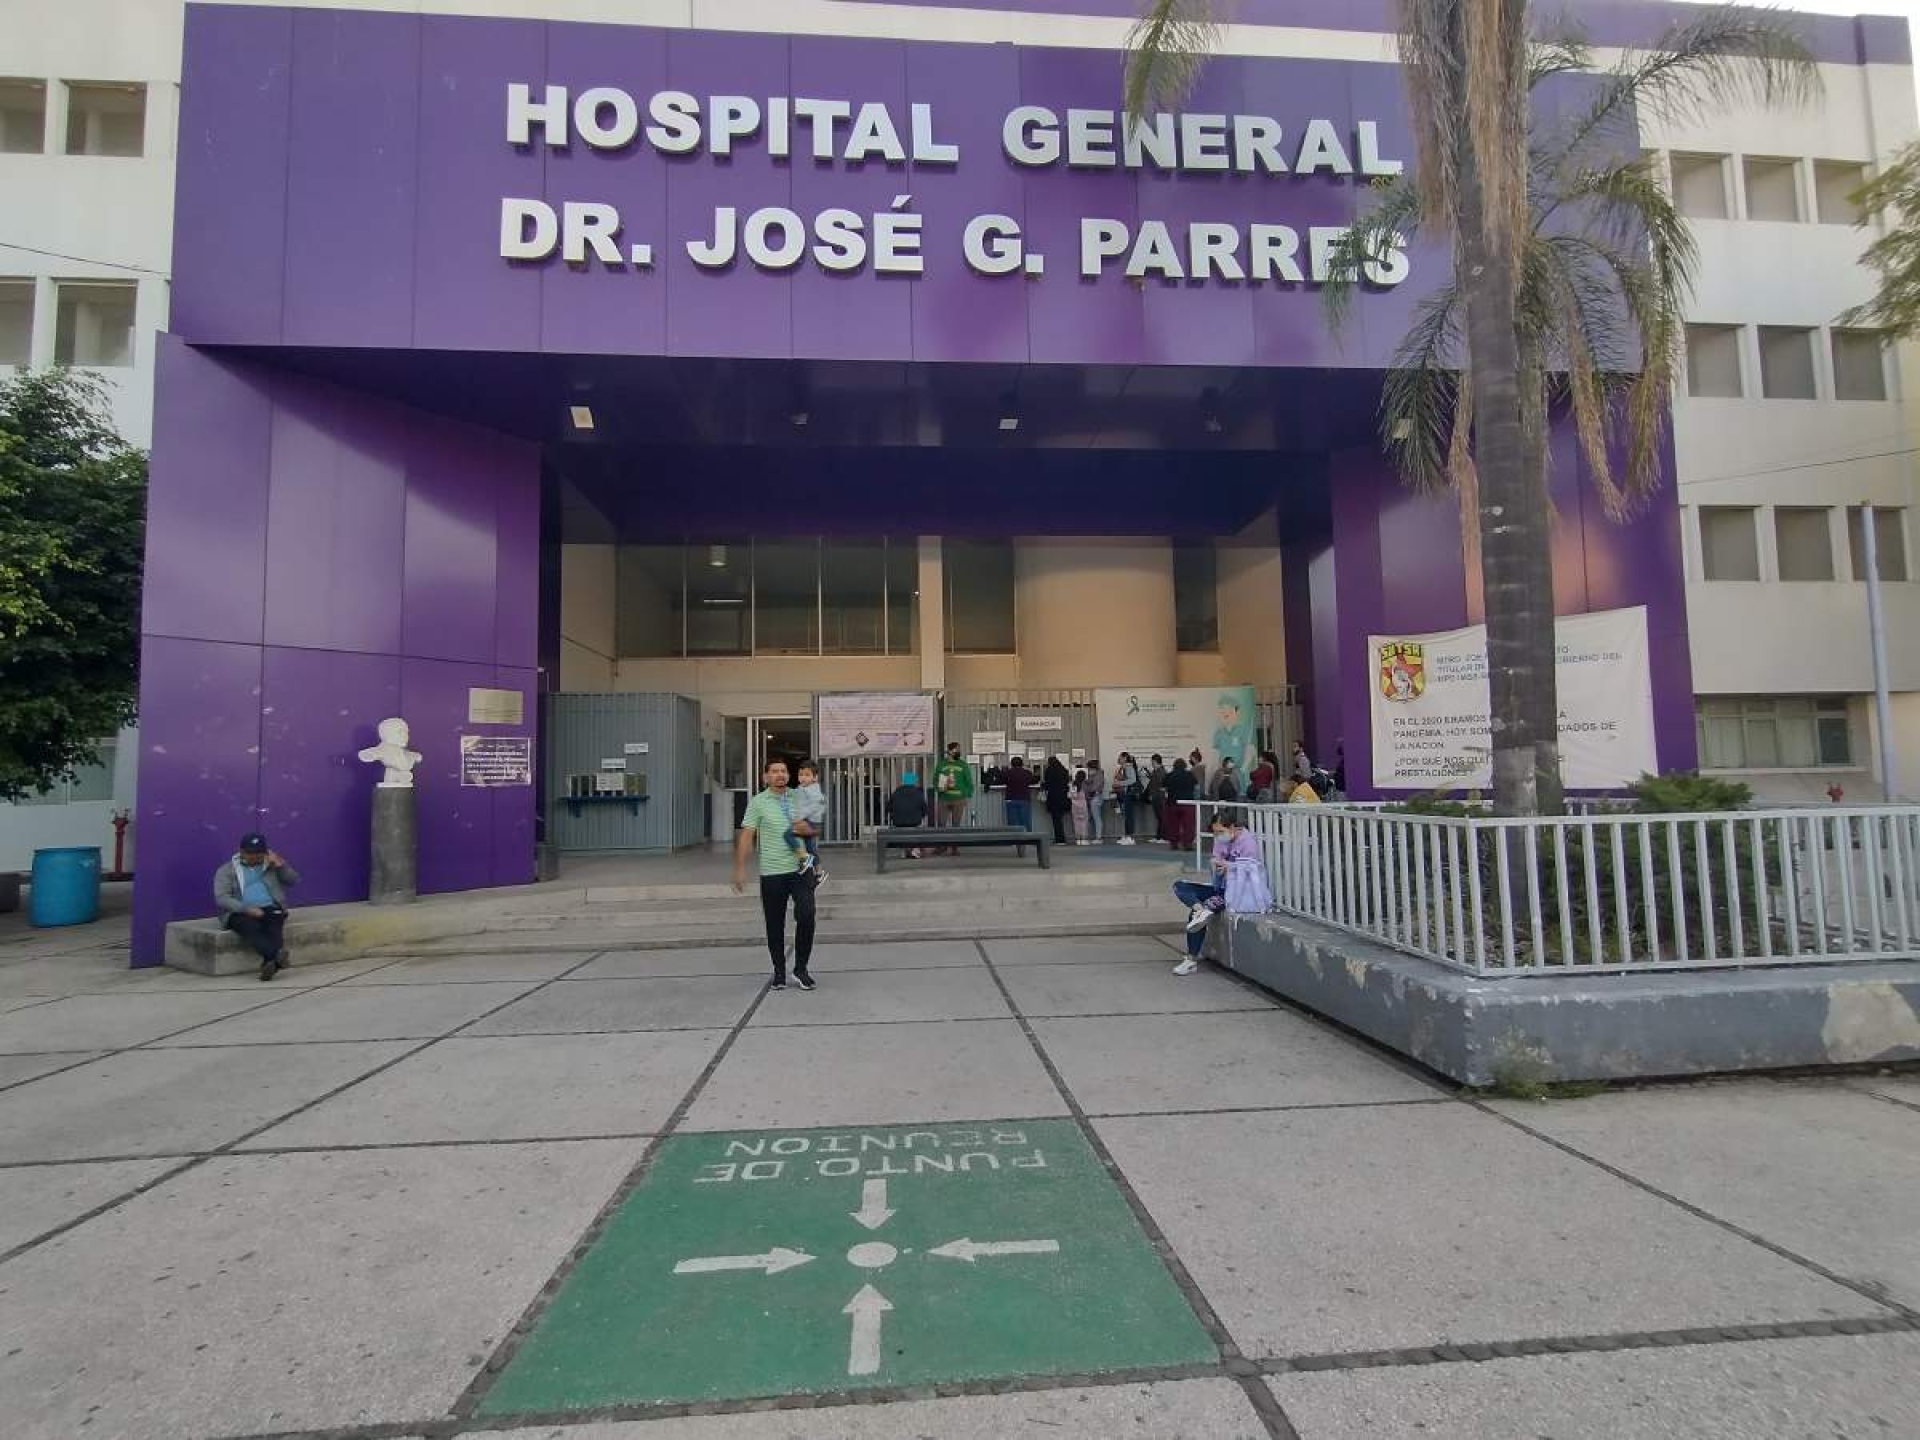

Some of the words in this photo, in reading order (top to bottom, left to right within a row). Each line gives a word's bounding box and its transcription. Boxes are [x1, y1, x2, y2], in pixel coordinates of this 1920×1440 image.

[506, 82, 960, 163] HOSPITAL
[1002, 106, 1403, 177] GENERAL
[500, 197, 653, 266] DR.
[686, 194, 924, 274] JOSÉ
[962, 213, 1044, 275] G.
[1080, 217, 1411, 286] PARRES
[1393, 717, 1405, 726] EN
[1407, 717, 1420, 726] EL
[1600, 721, 1617, 731] DE
[1394, 741, 1405, 750] LA
[723, 1129, 1028, 1157] REUNION
[692, 1160, 788, 1184] DE
[818, 1149, 1048, 1178] PUNTO
